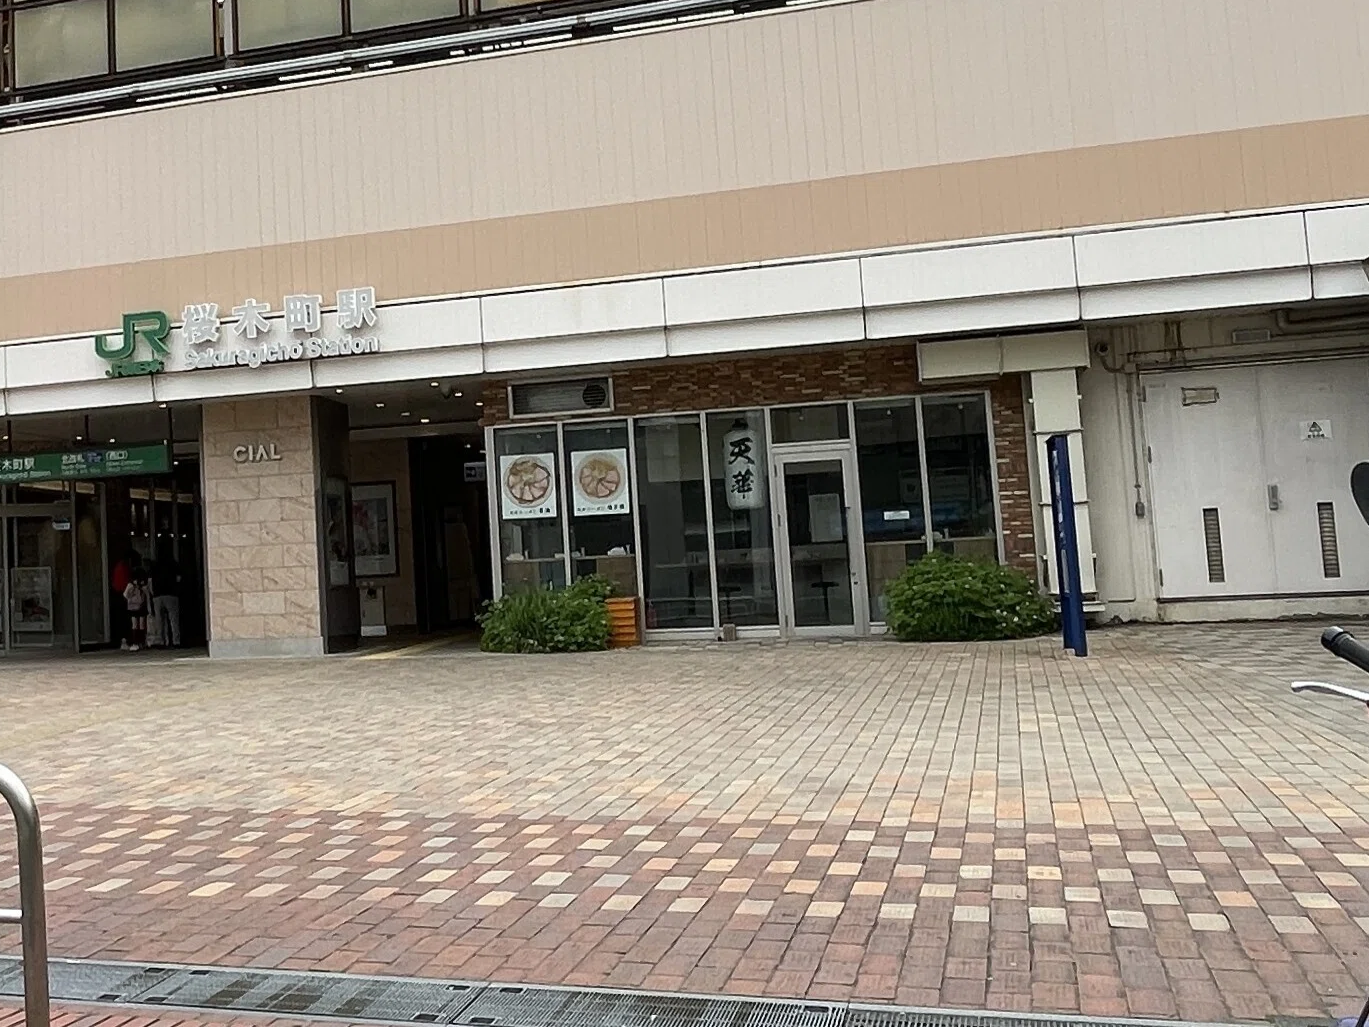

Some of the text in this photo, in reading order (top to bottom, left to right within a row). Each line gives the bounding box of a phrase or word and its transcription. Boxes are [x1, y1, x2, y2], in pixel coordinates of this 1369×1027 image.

[182, 286, 377, 345] 桜木町駅
[95, 310, 171, 361] JR
[306, 333, 381, 359] Station
[233, 443, 282, 463] CIAL
